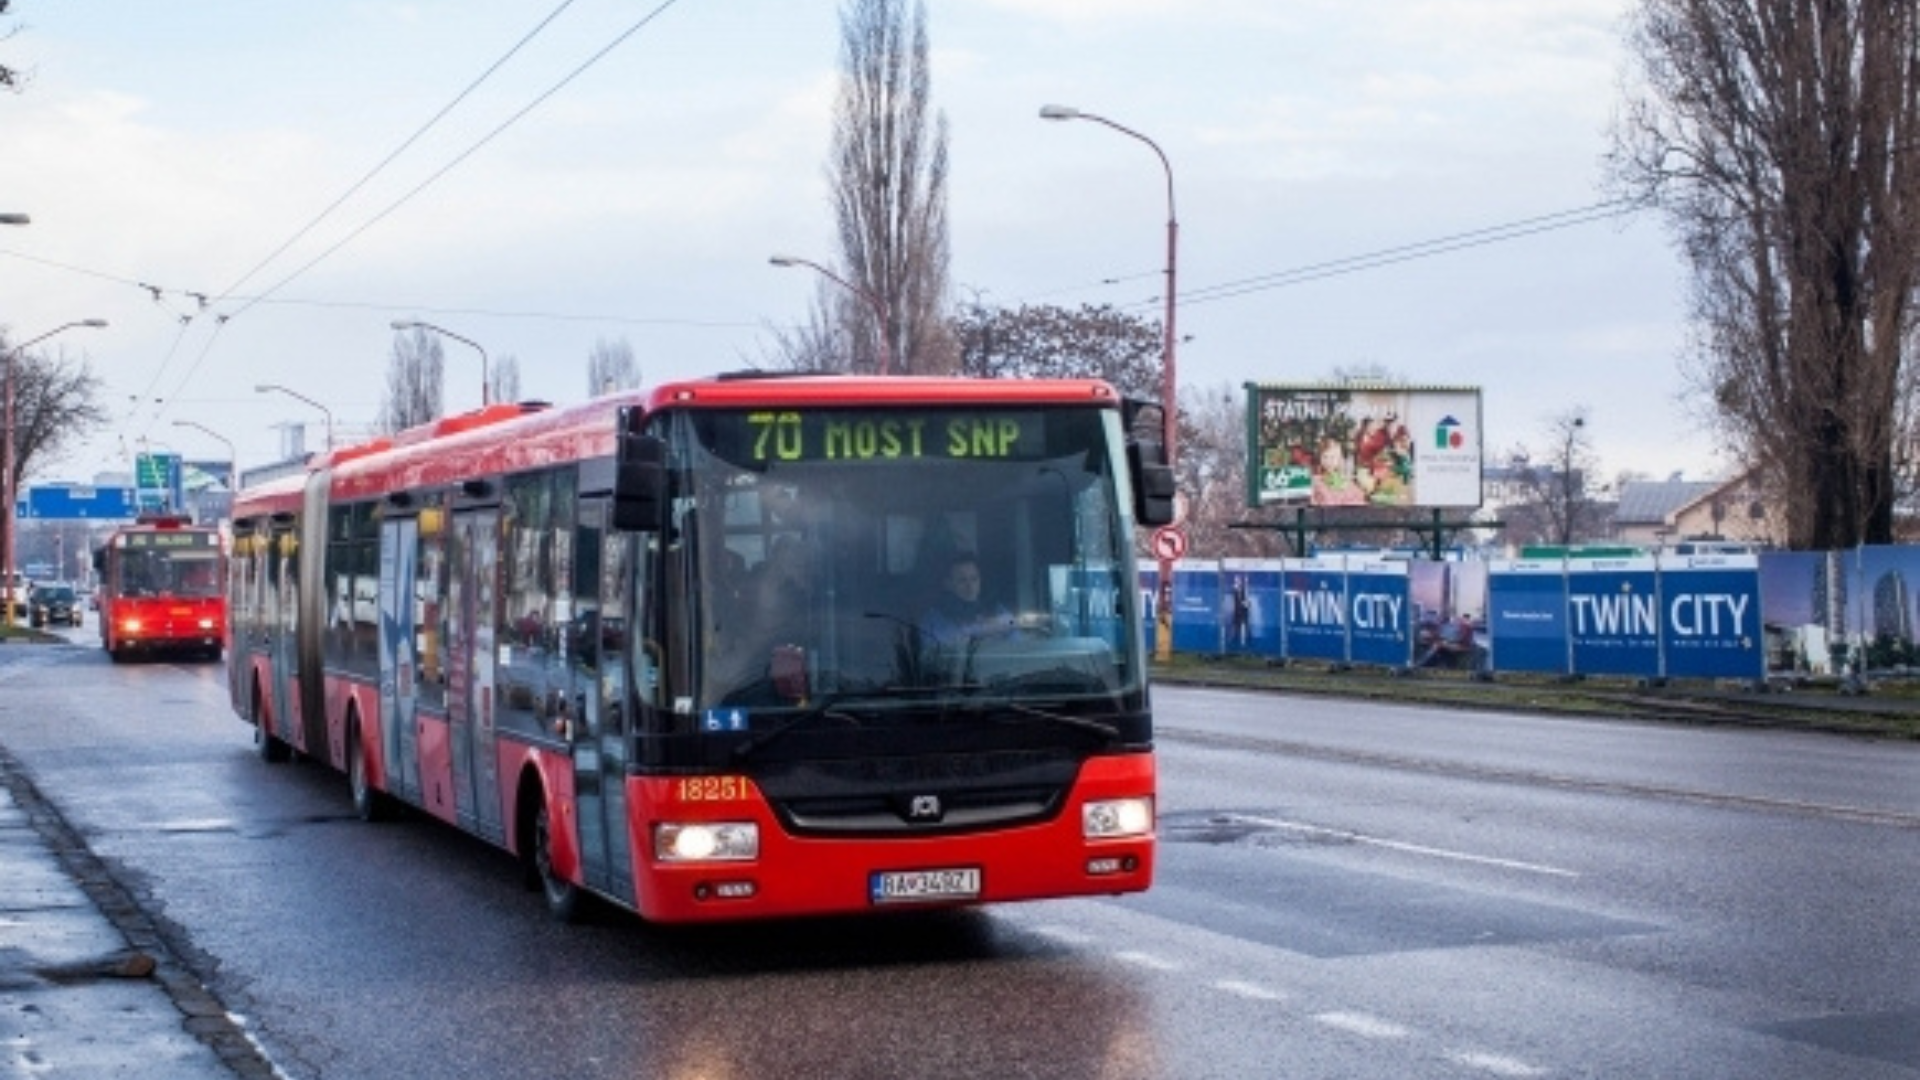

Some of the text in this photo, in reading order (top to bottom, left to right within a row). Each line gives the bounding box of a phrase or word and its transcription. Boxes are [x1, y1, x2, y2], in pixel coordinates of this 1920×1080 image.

[747, 411, 1020, 460] 70 MOST SNP
[1284, 586, 1402, 632] TWIN CITY
[1571, 590, 1749, 636] TWIN CITY
